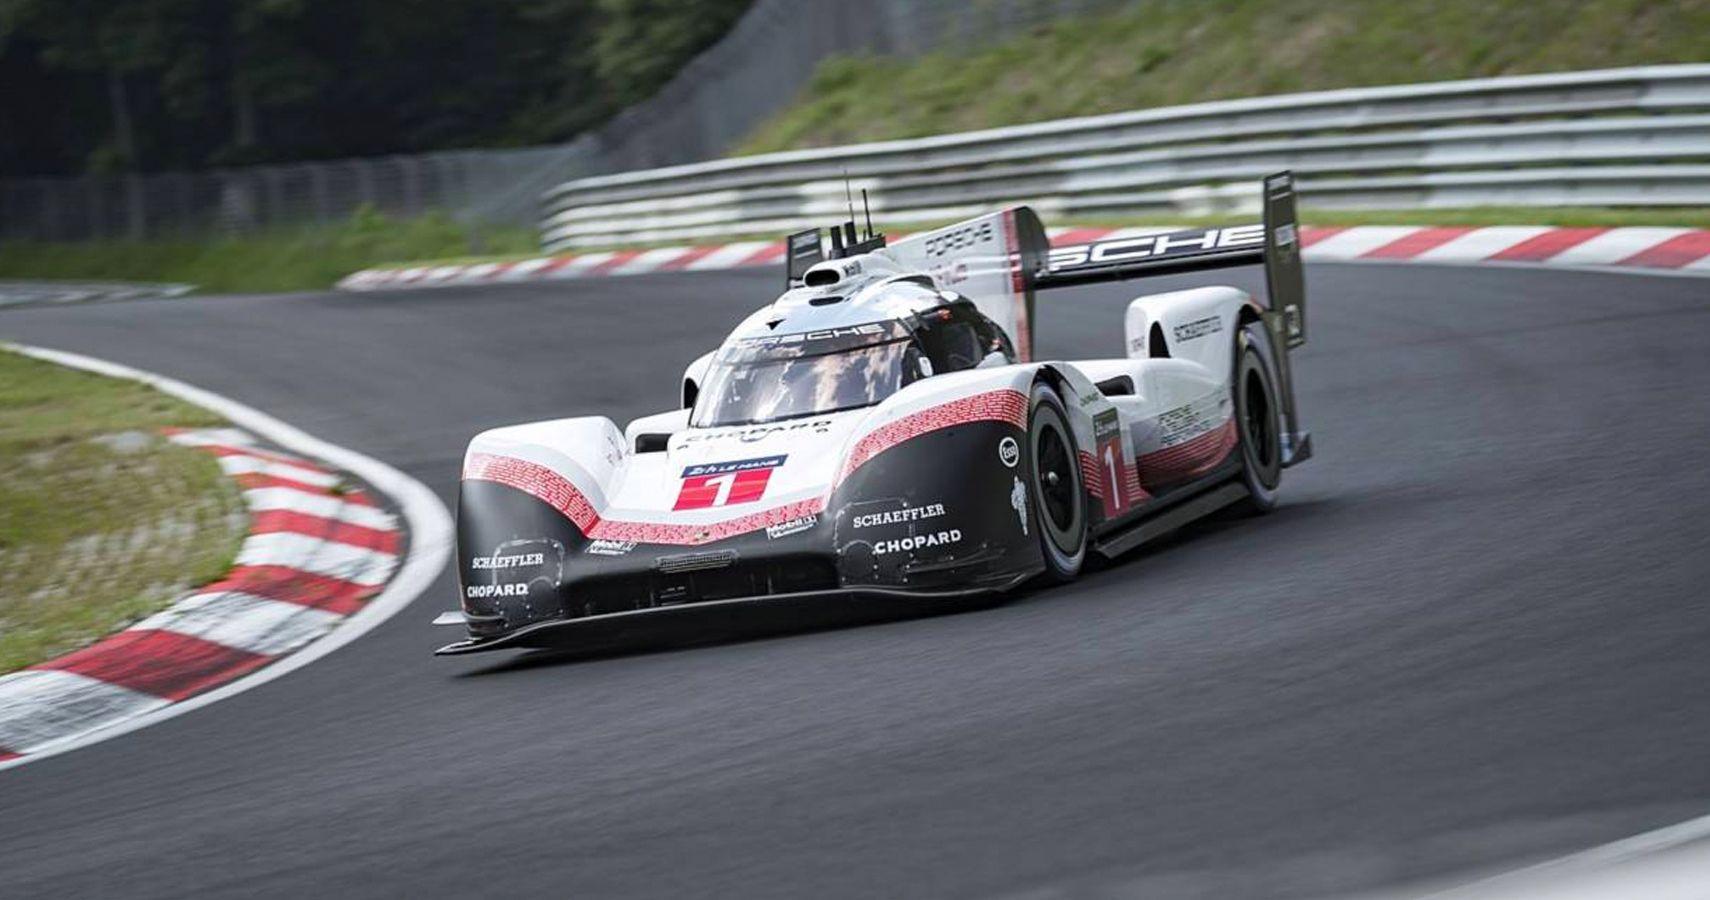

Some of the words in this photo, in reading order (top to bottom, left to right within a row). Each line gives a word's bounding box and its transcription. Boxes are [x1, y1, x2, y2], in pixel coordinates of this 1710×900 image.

[925, 222, 993, 257] PORSCHE
[1048, 224, 1266, 272] SCHE
[704, 472, 737, 506] 1
[1104, 445, 1120, 509] 1
[853, 503, 946, 529] SCHAEFFLER
[874, 529, 962, 554] CHOPARD
[472, 553, 544, 570] SCHAEFFLER
[467, 583, 529, 598] CHOPARD
